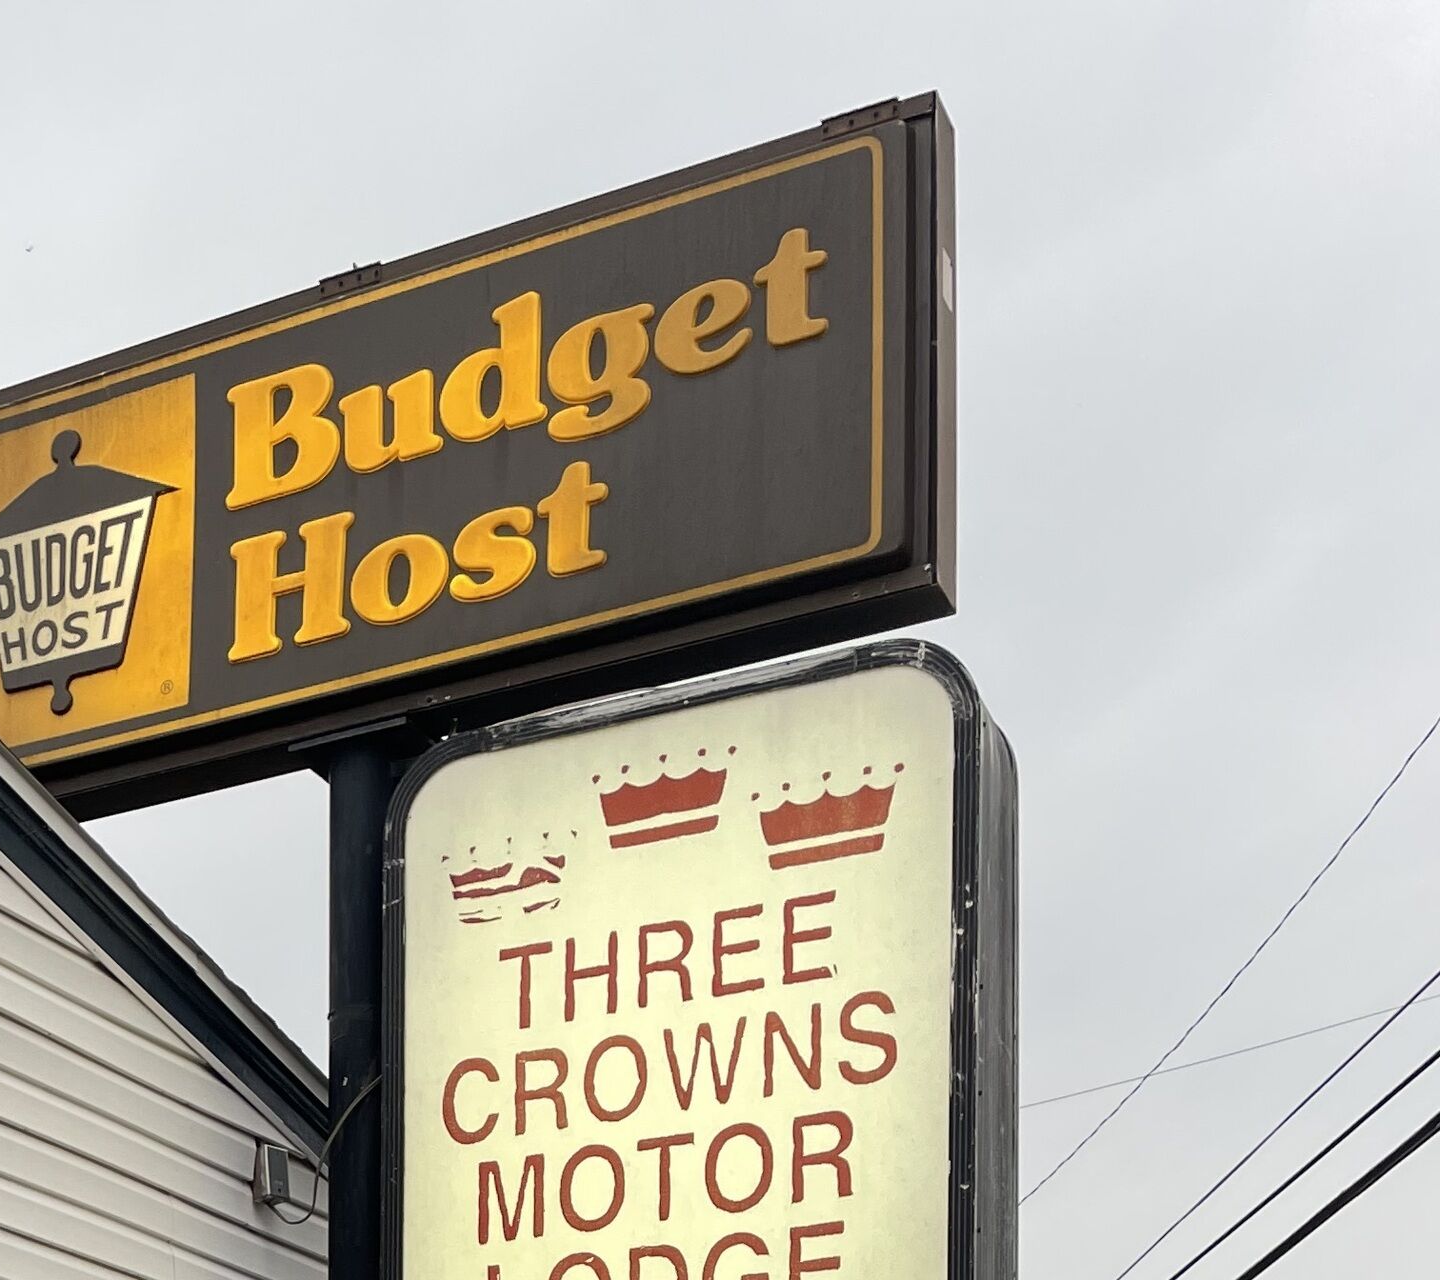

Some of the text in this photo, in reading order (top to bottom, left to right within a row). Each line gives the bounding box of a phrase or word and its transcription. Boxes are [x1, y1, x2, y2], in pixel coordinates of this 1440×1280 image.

[226, 227, 828, 510] Budget
[1, 600, 125, 664] HOST
[227, 461, 608, 664] Host
[499, 890, 837, 1029] THREE
[442, 991, 898, 1145] CROWNS
[478, 1110, 853, 1245] MOTOR
